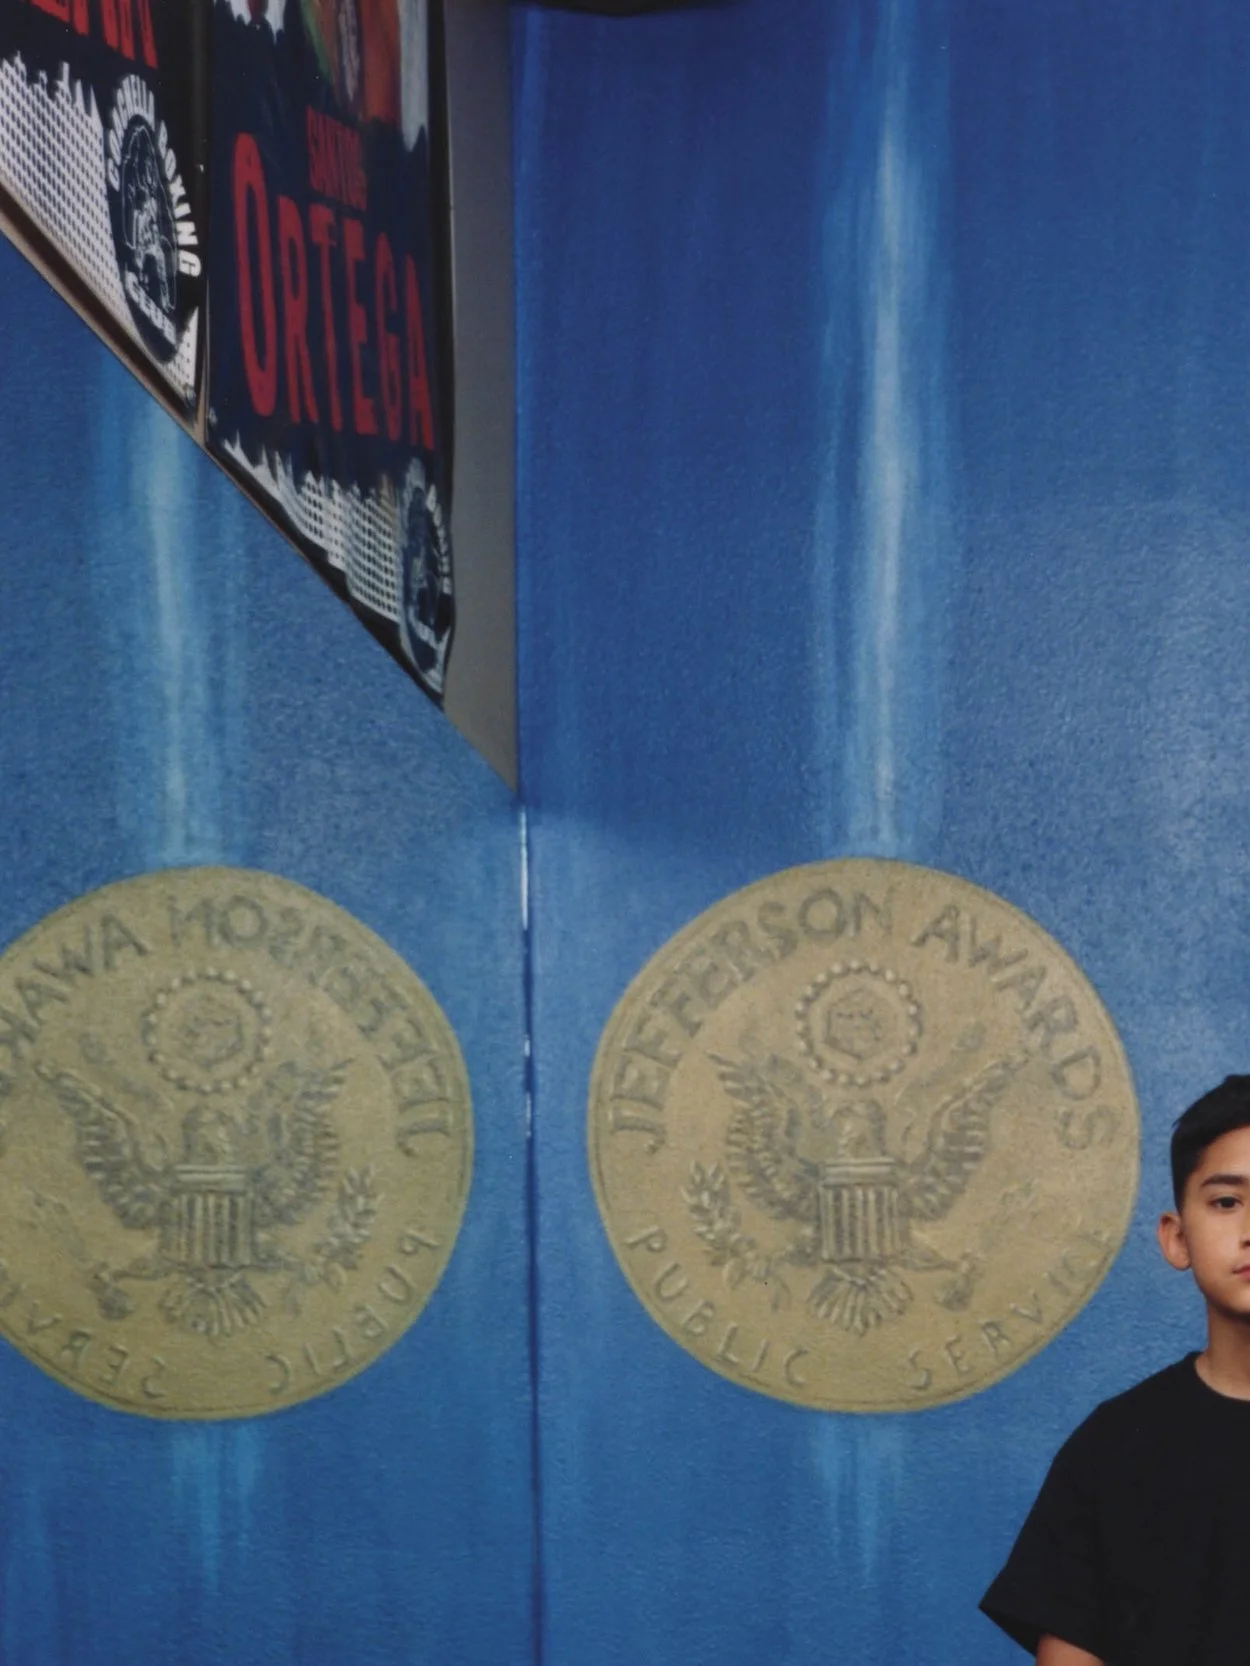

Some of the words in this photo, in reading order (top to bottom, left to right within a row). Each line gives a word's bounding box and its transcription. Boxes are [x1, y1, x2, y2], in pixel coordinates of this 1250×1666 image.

[158, 119, 202, 279] BOXING
[233, 131, 435, 450] ORTEGA
[608, 886, 896, 1156] JEFFERSON
[911, 904, 1121, 1153] AWARDS
[625, 1224, 810, 1389] PUBLIC
